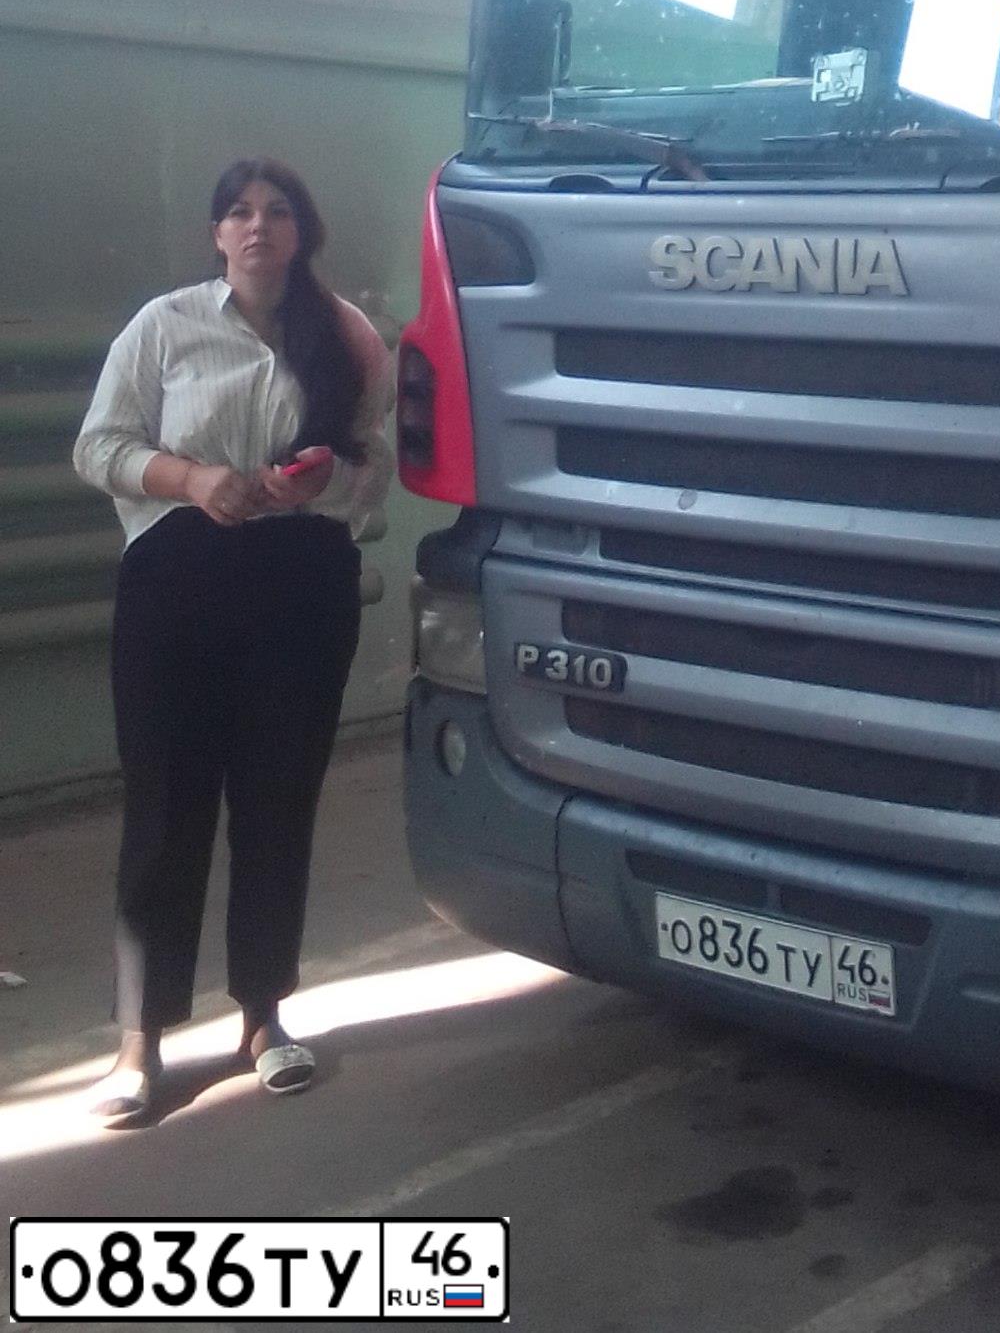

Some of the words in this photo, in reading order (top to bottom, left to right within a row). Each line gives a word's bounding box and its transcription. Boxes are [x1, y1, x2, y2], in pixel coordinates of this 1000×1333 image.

[648, 234, 909, 296] SCANIA
[516, 645, 539, 672] P
[544, 649, 613, 688] 310
[837, 945, 877, 986] 46
[836, 982, 868, 1002] RUS
